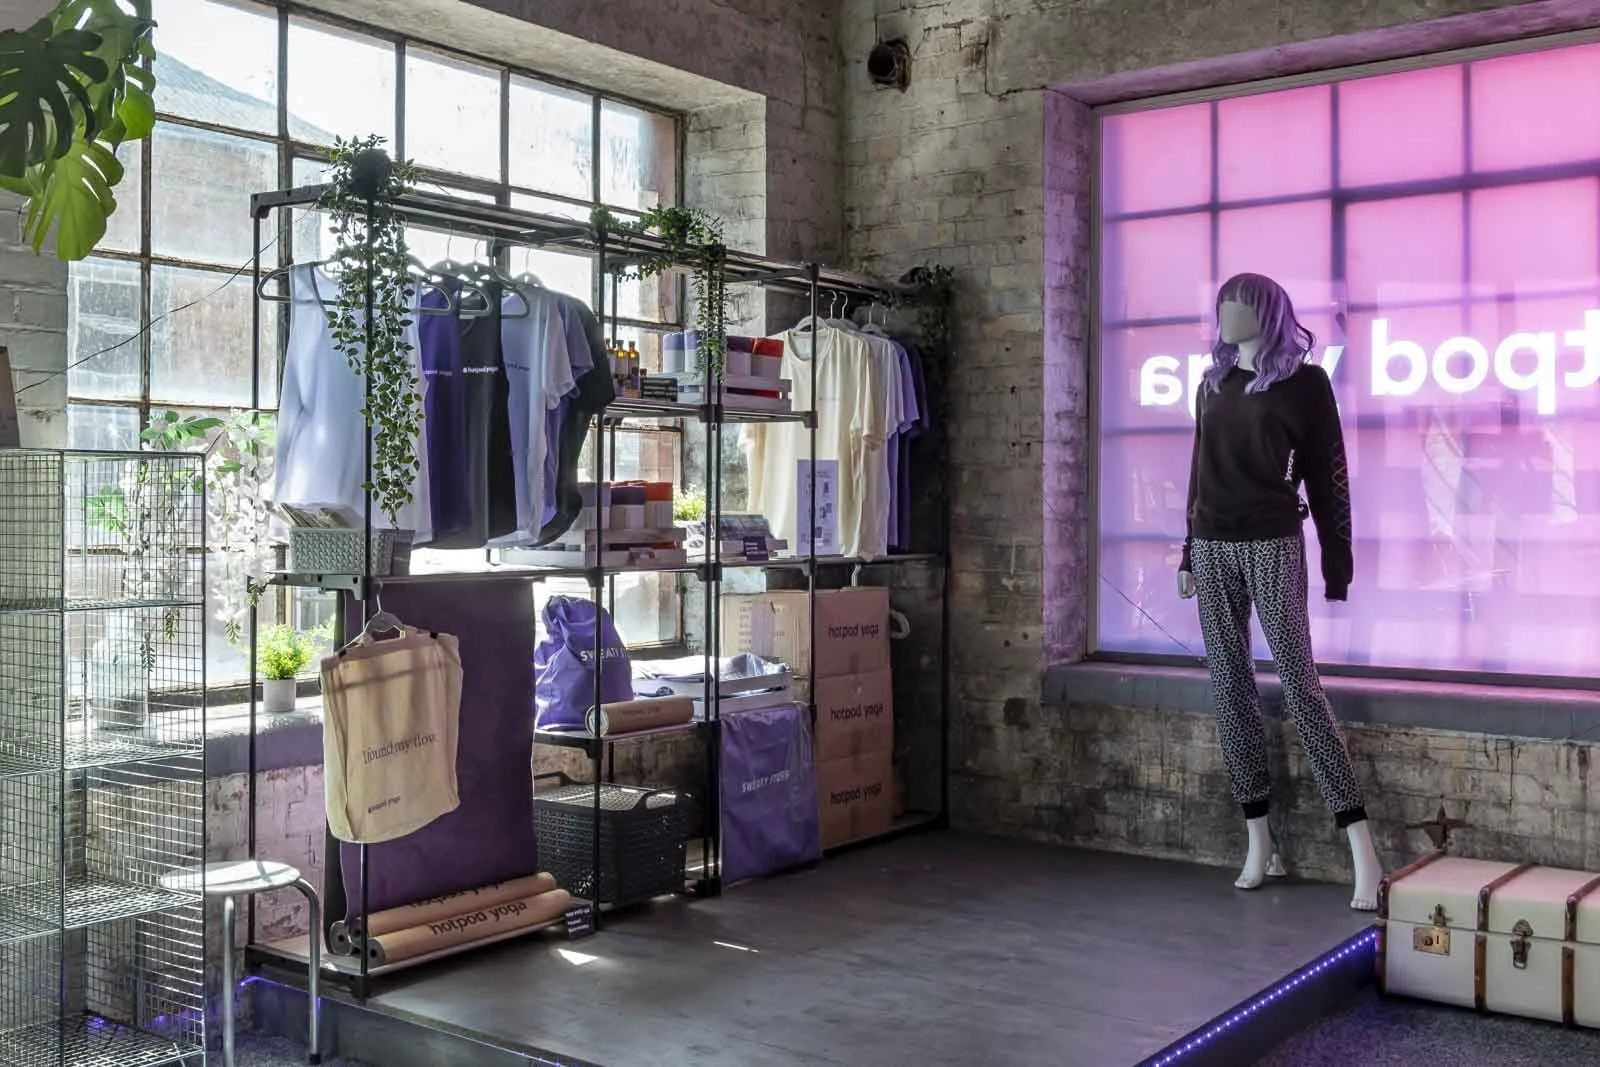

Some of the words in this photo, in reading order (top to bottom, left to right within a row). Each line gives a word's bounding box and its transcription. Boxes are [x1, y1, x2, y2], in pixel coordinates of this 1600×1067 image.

[828, 623, 859, 640] hotpod
[861, 623, 880, 639] yoga
[830, 704, 862, 721] hotpod
[863, 703, 884, 719] yoga
[830, 787, 861, 807] hotpod
[863, 781, 883, 803] yoga
[430, 912, 486, 936] hotpod
[492, 900, 528, 922] yoga
